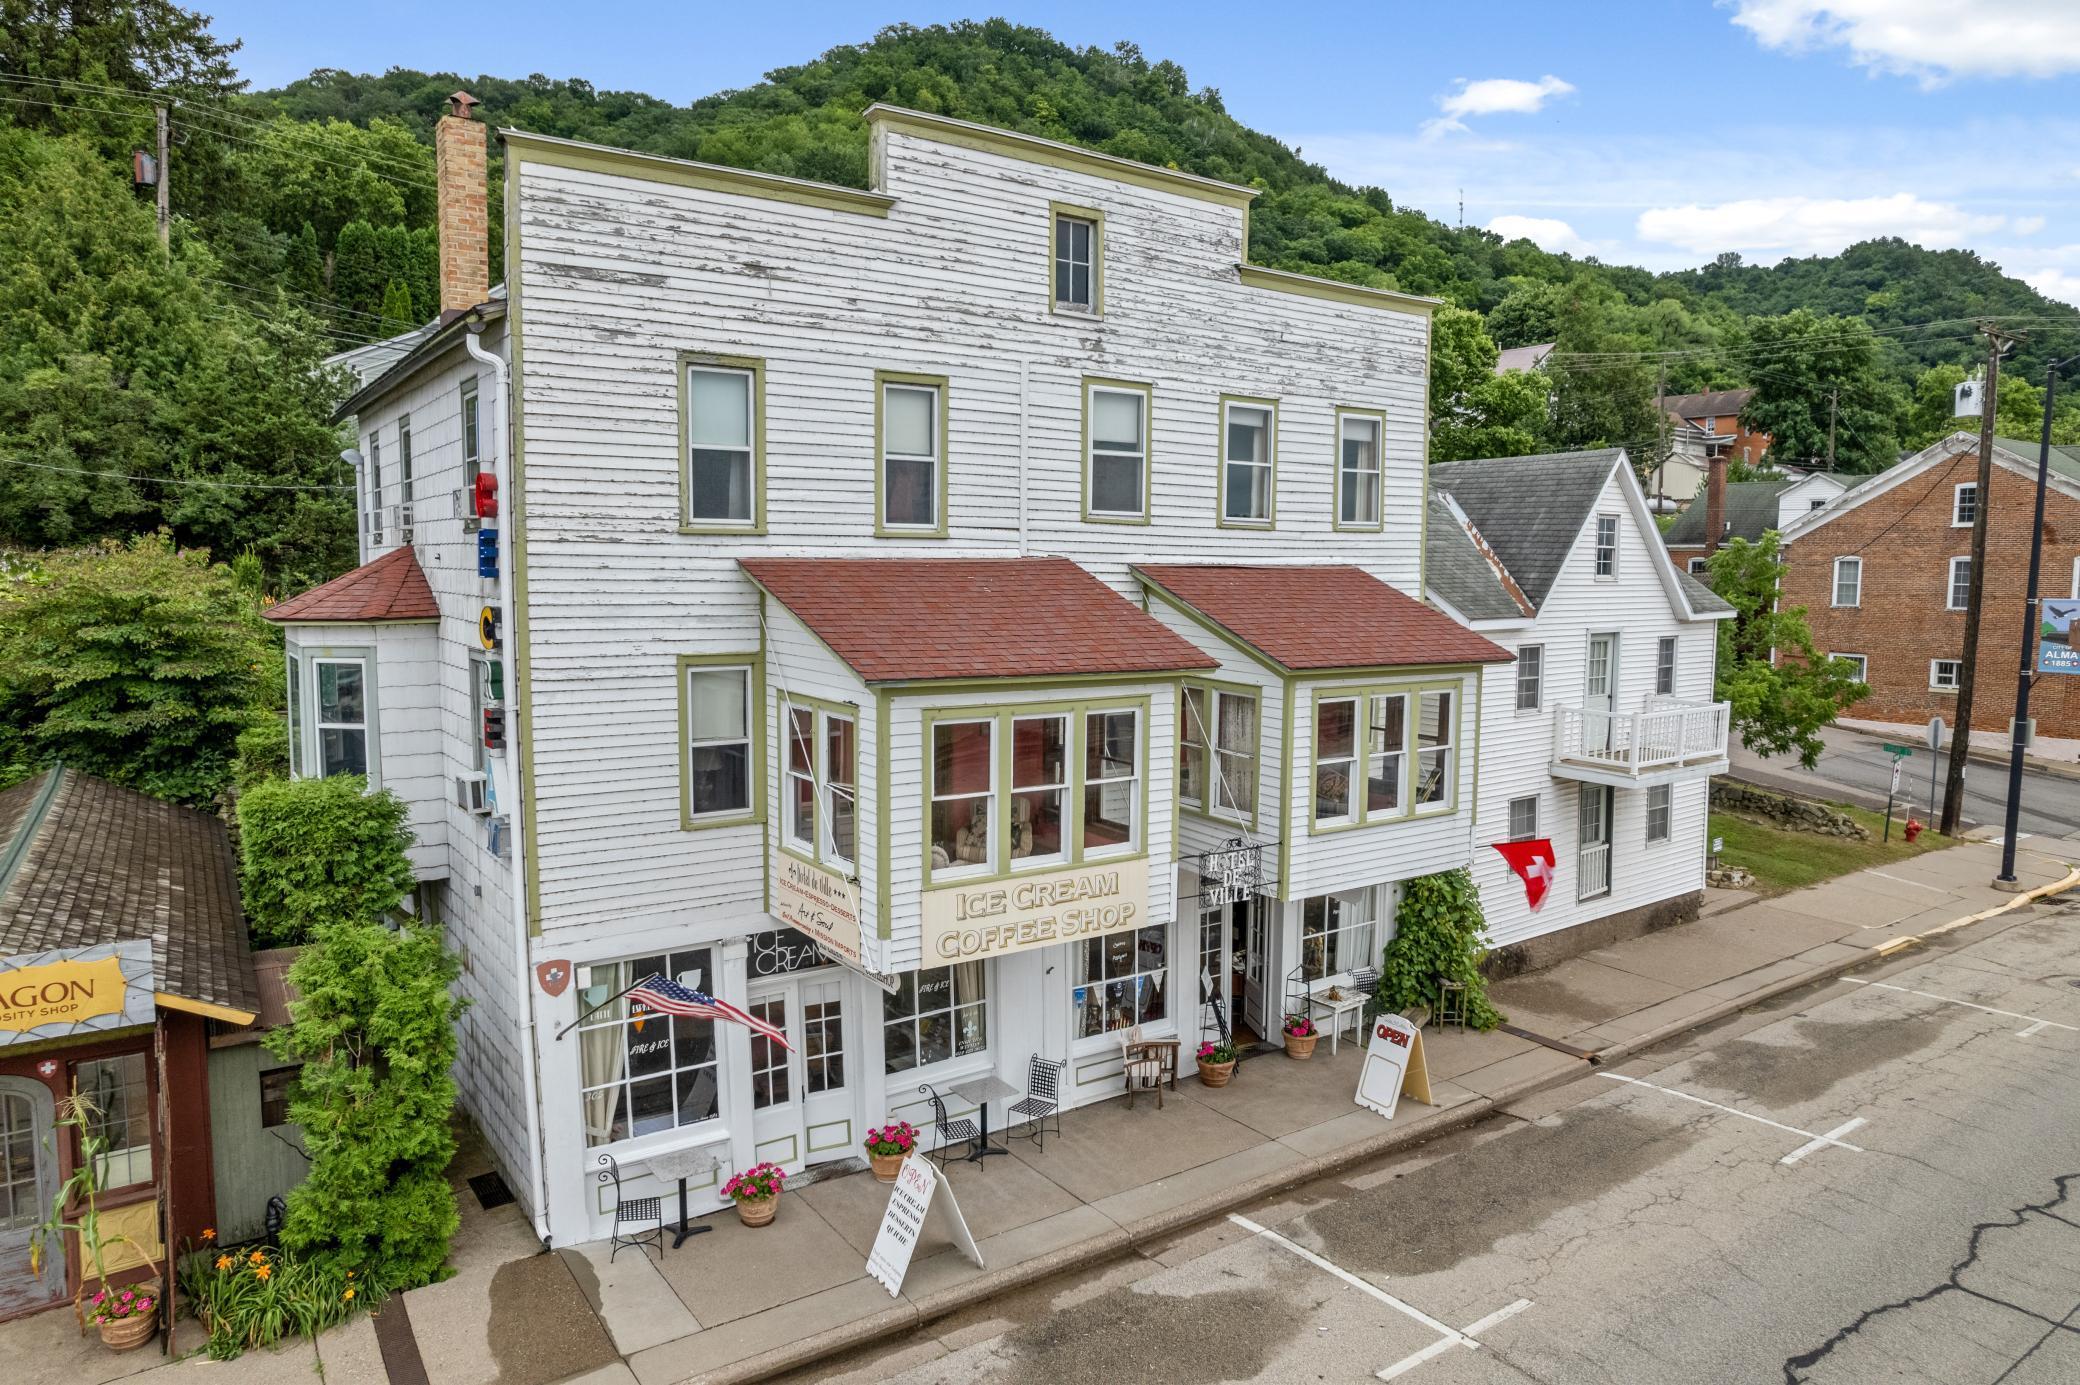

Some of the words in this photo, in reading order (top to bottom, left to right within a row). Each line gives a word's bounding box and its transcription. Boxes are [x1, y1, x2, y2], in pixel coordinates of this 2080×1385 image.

[2045, 650, 2078, 660] ALMA
[1208, 849, 1255, 872] HOTEL
[1223, 869, 1242, 887] DE
[956, 889, 1008, 921] ICE
[1011, 871, 1120, 911] CREAM
[1208, 884, 1252, 906] VILLE
[753, 930, 785, 953] ICE
[936, 915, 1057, 959] COFFEE
[1061, 902, 1136, 937] SHOP
[755, 943, 828, 975] CREAM
[0, 1010, 35, 1022] SITY
[40, 1003, 79, 1016] SHOP
[657, 1038, 670, 1050] ICE
[1377, 1023, 1410, 1049] OPEN
[892, 1198, 921, 1225] ESPRESSO
[894, 1185, 904, 1196] ICE
[904, 1193, 926, 1215] CREAM
[886, 1224, 909, 1246] QUICHE
[887, 1210, 915, 1237] DESSERTS
